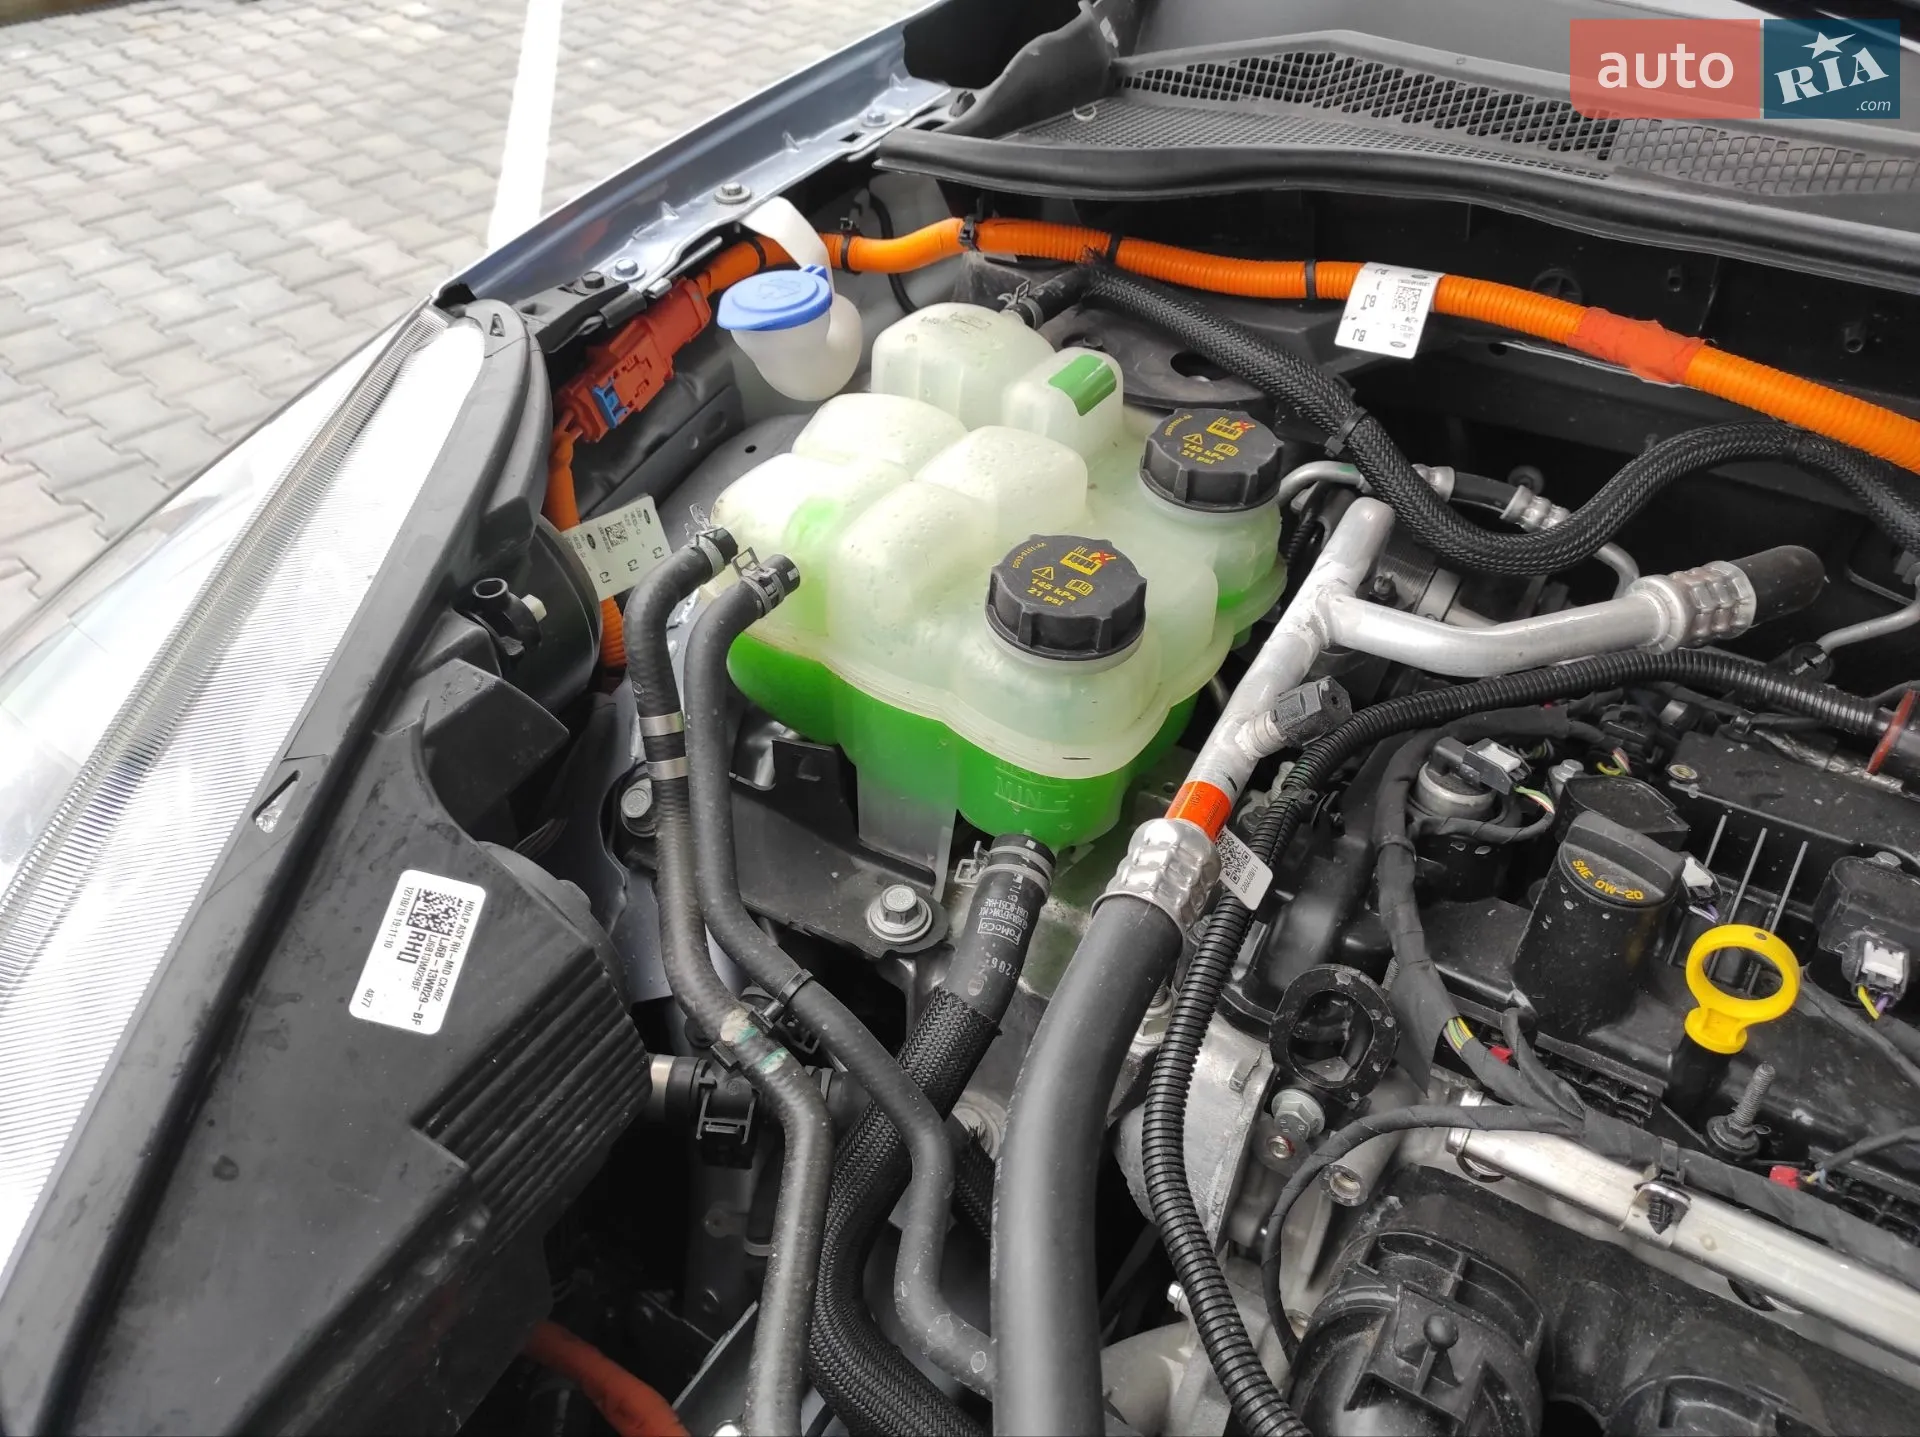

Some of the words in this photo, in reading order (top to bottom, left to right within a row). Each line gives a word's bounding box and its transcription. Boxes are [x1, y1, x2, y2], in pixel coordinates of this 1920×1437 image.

[1352, 328, 1367, 342] BJ
[1183, 442, 1203, 453] 145
[652, 546, 665, 559] CJ
[627, 559, 640, 572] CJ
[599, 571, 612, 584] CJ
[1027, 587, 1043, 597] 21
[1043, 595, 1065, 607] psi
[1031, 578, 1053, 591] 145
[1053, 588, 1076, 602] kPa
[1572, 859, 1594, 879] SAE
[981, 921, 1021, 943] FoMoCo
[361, 988, 375, 1008] 4877
